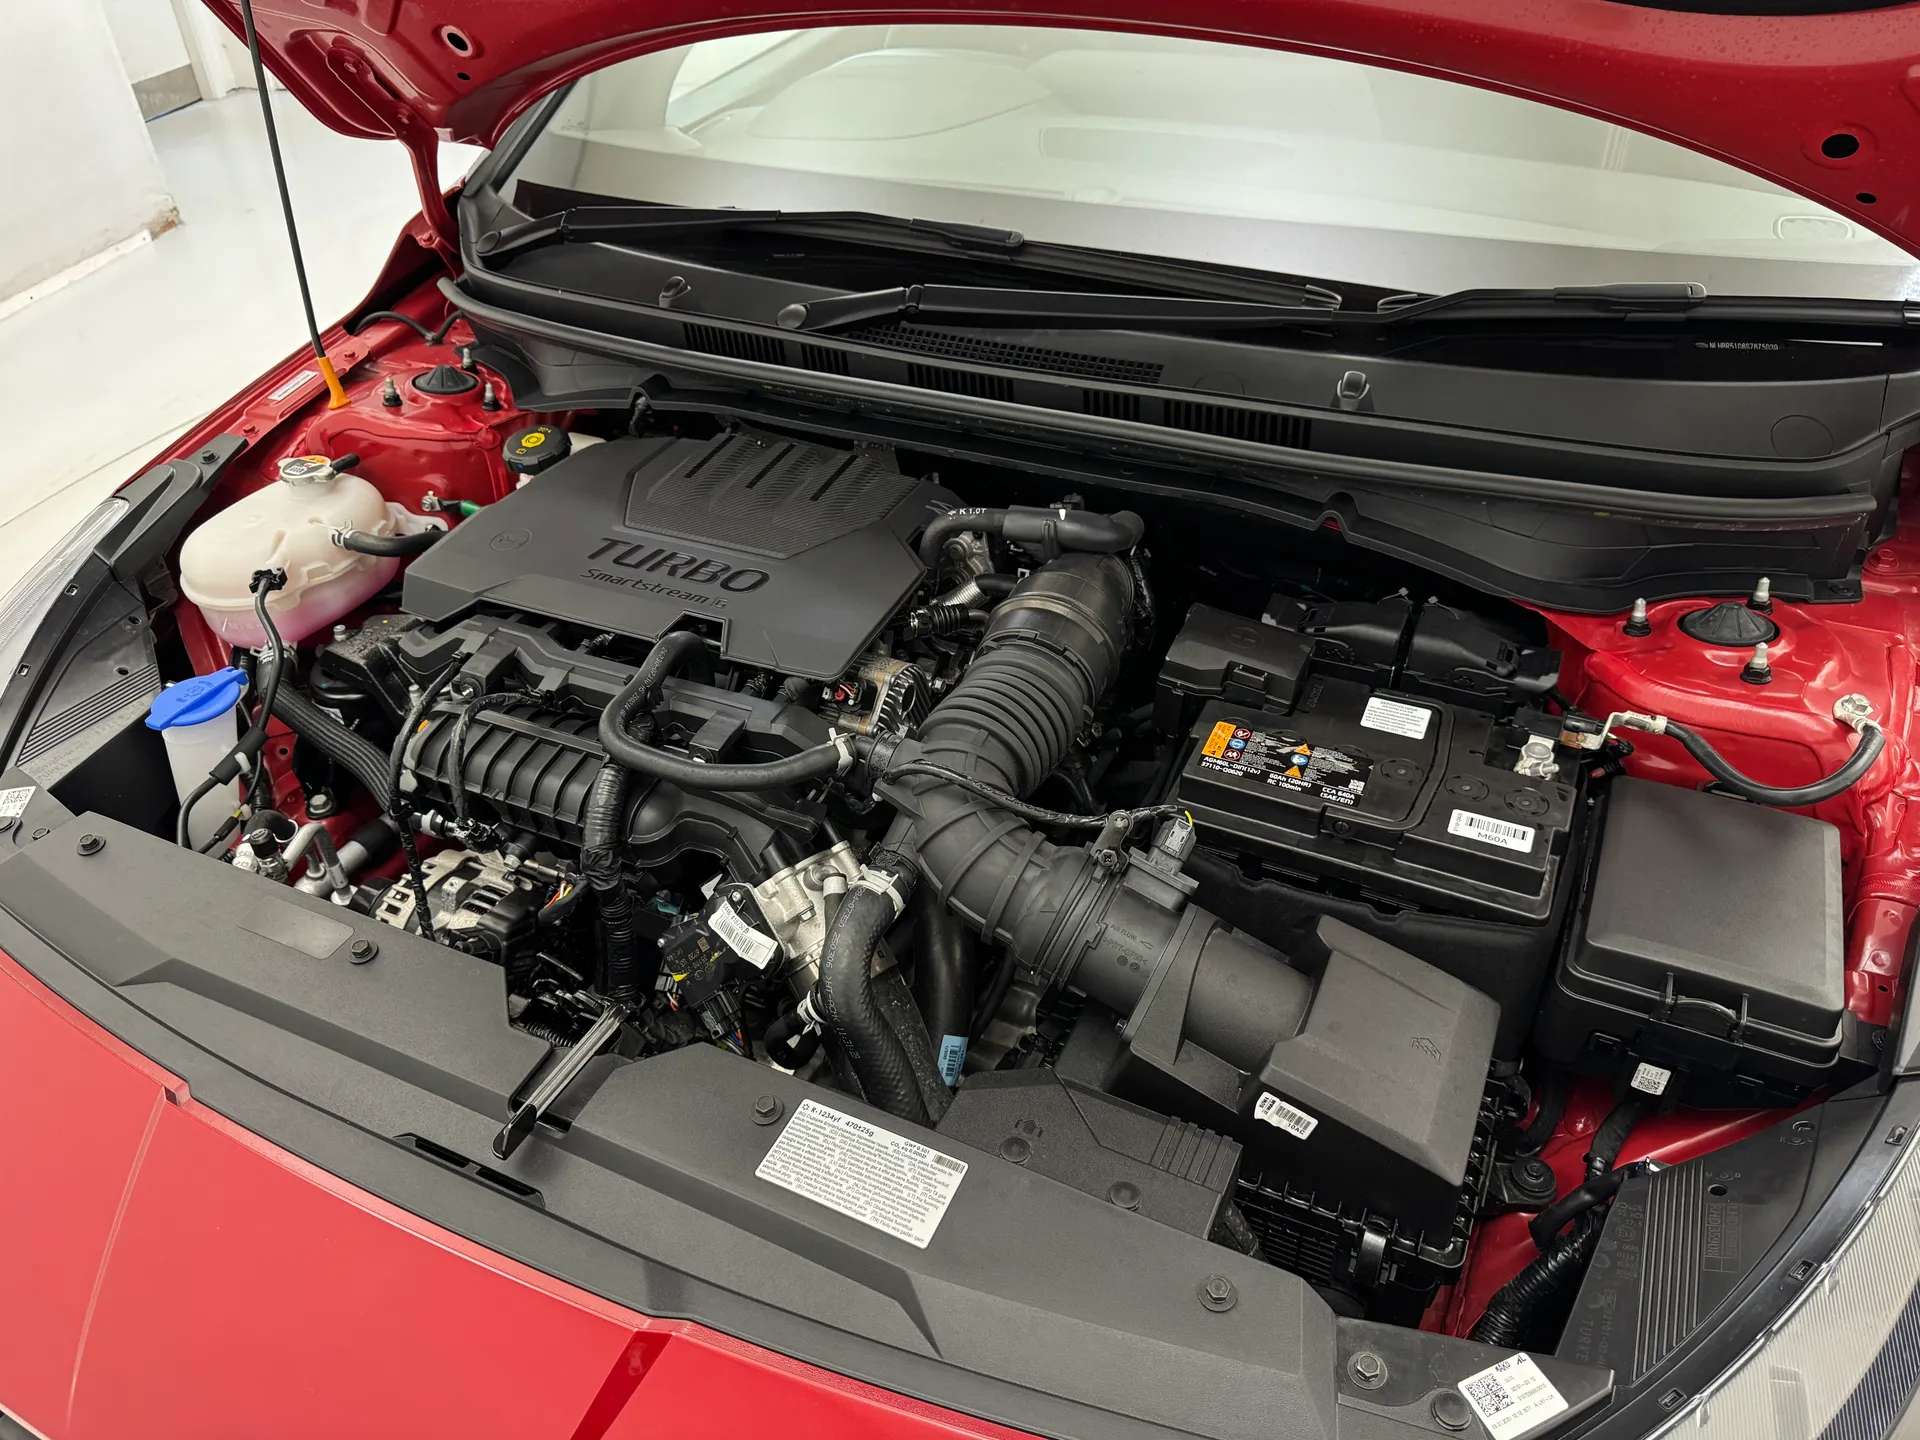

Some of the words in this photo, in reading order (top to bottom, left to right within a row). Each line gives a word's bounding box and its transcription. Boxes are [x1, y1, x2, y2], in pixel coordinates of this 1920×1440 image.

[587, 537, 770, 593] TURBO
[580, 568, 710, 605] Smartstream
[1270, 773, 1286, 782] 60Ah
[1278, 781, 1302, 792] 100min
[1322, 786, 1336, 795] CCA
[1478, 832, 1508, 846] M60A
[810, 1107, 842, 1122] R-1234yf
[845, 1120, 874, 1137] 470±25g
[1288, 1122, 1305, 1135] 10AC
